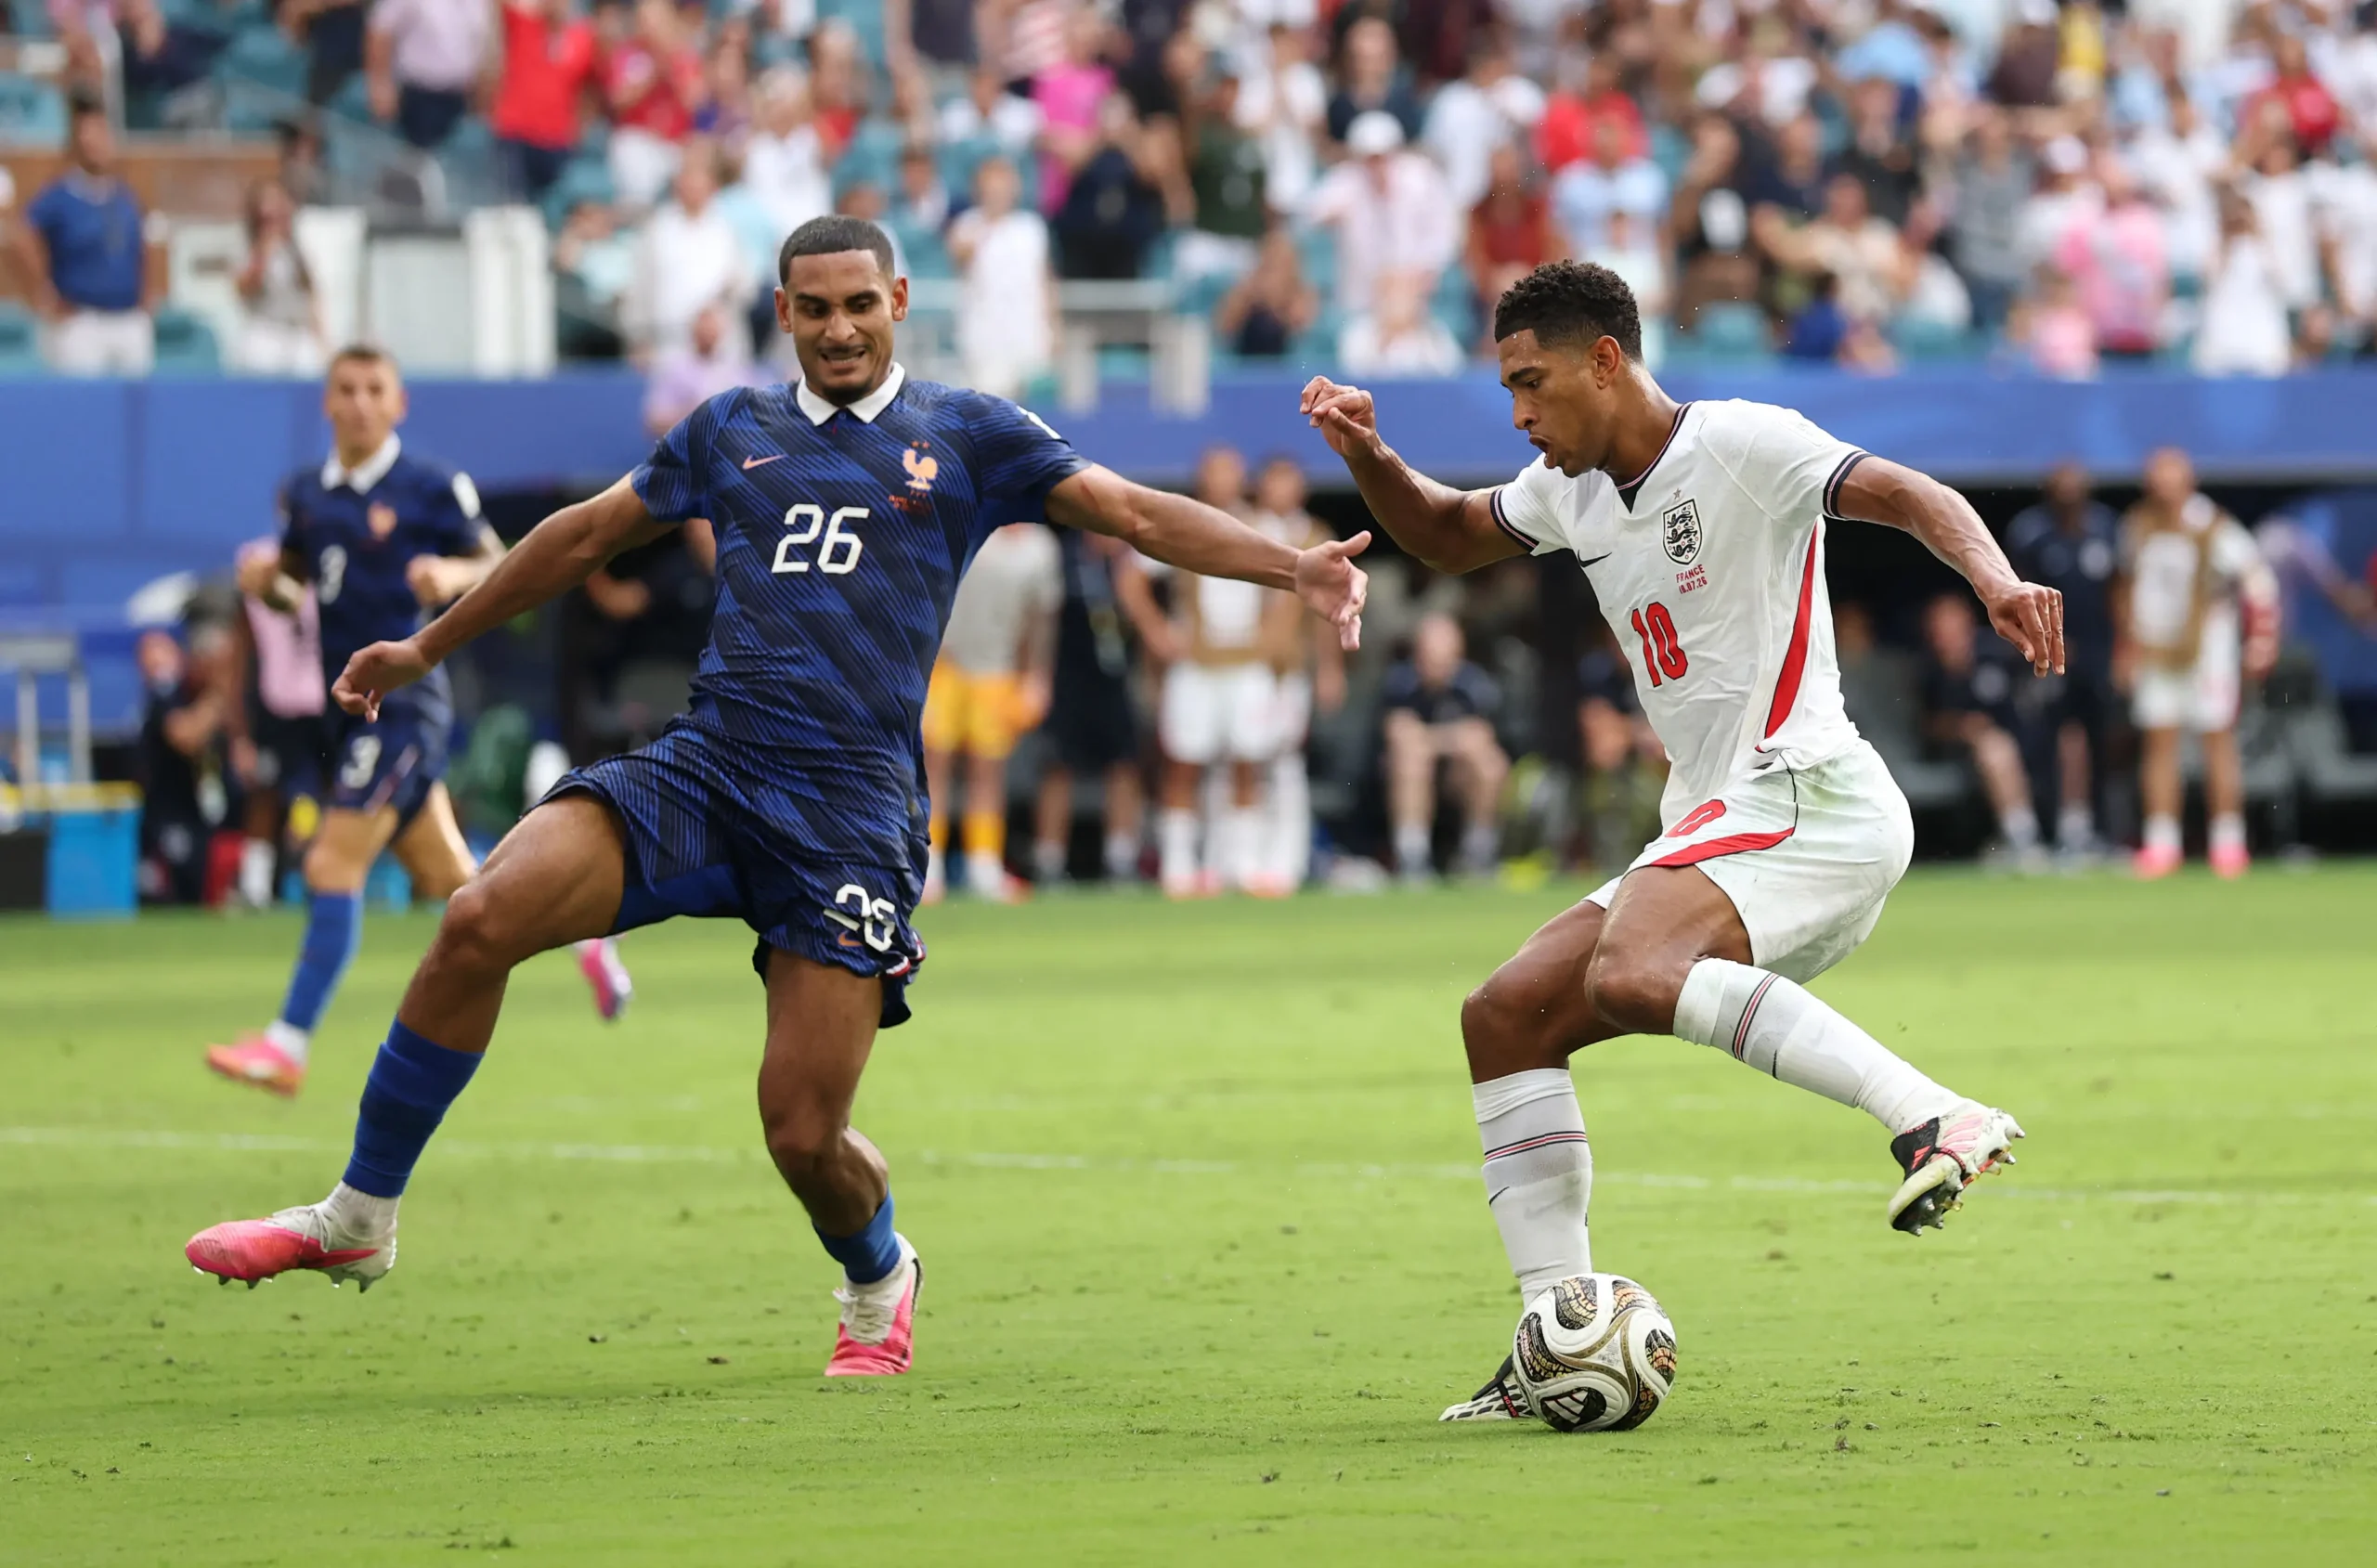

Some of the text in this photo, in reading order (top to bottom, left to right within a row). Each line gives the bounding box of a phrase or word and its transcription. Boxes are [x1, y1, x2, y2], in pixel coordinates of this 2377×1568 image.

[772, 504, 870, 574] 26
[1676, 564, 1705, 583] FRANCE
[1630, 601, 1689, 688] 10
[341, 736, 382, 788] 3
[823, 884, 895, 952] 26
